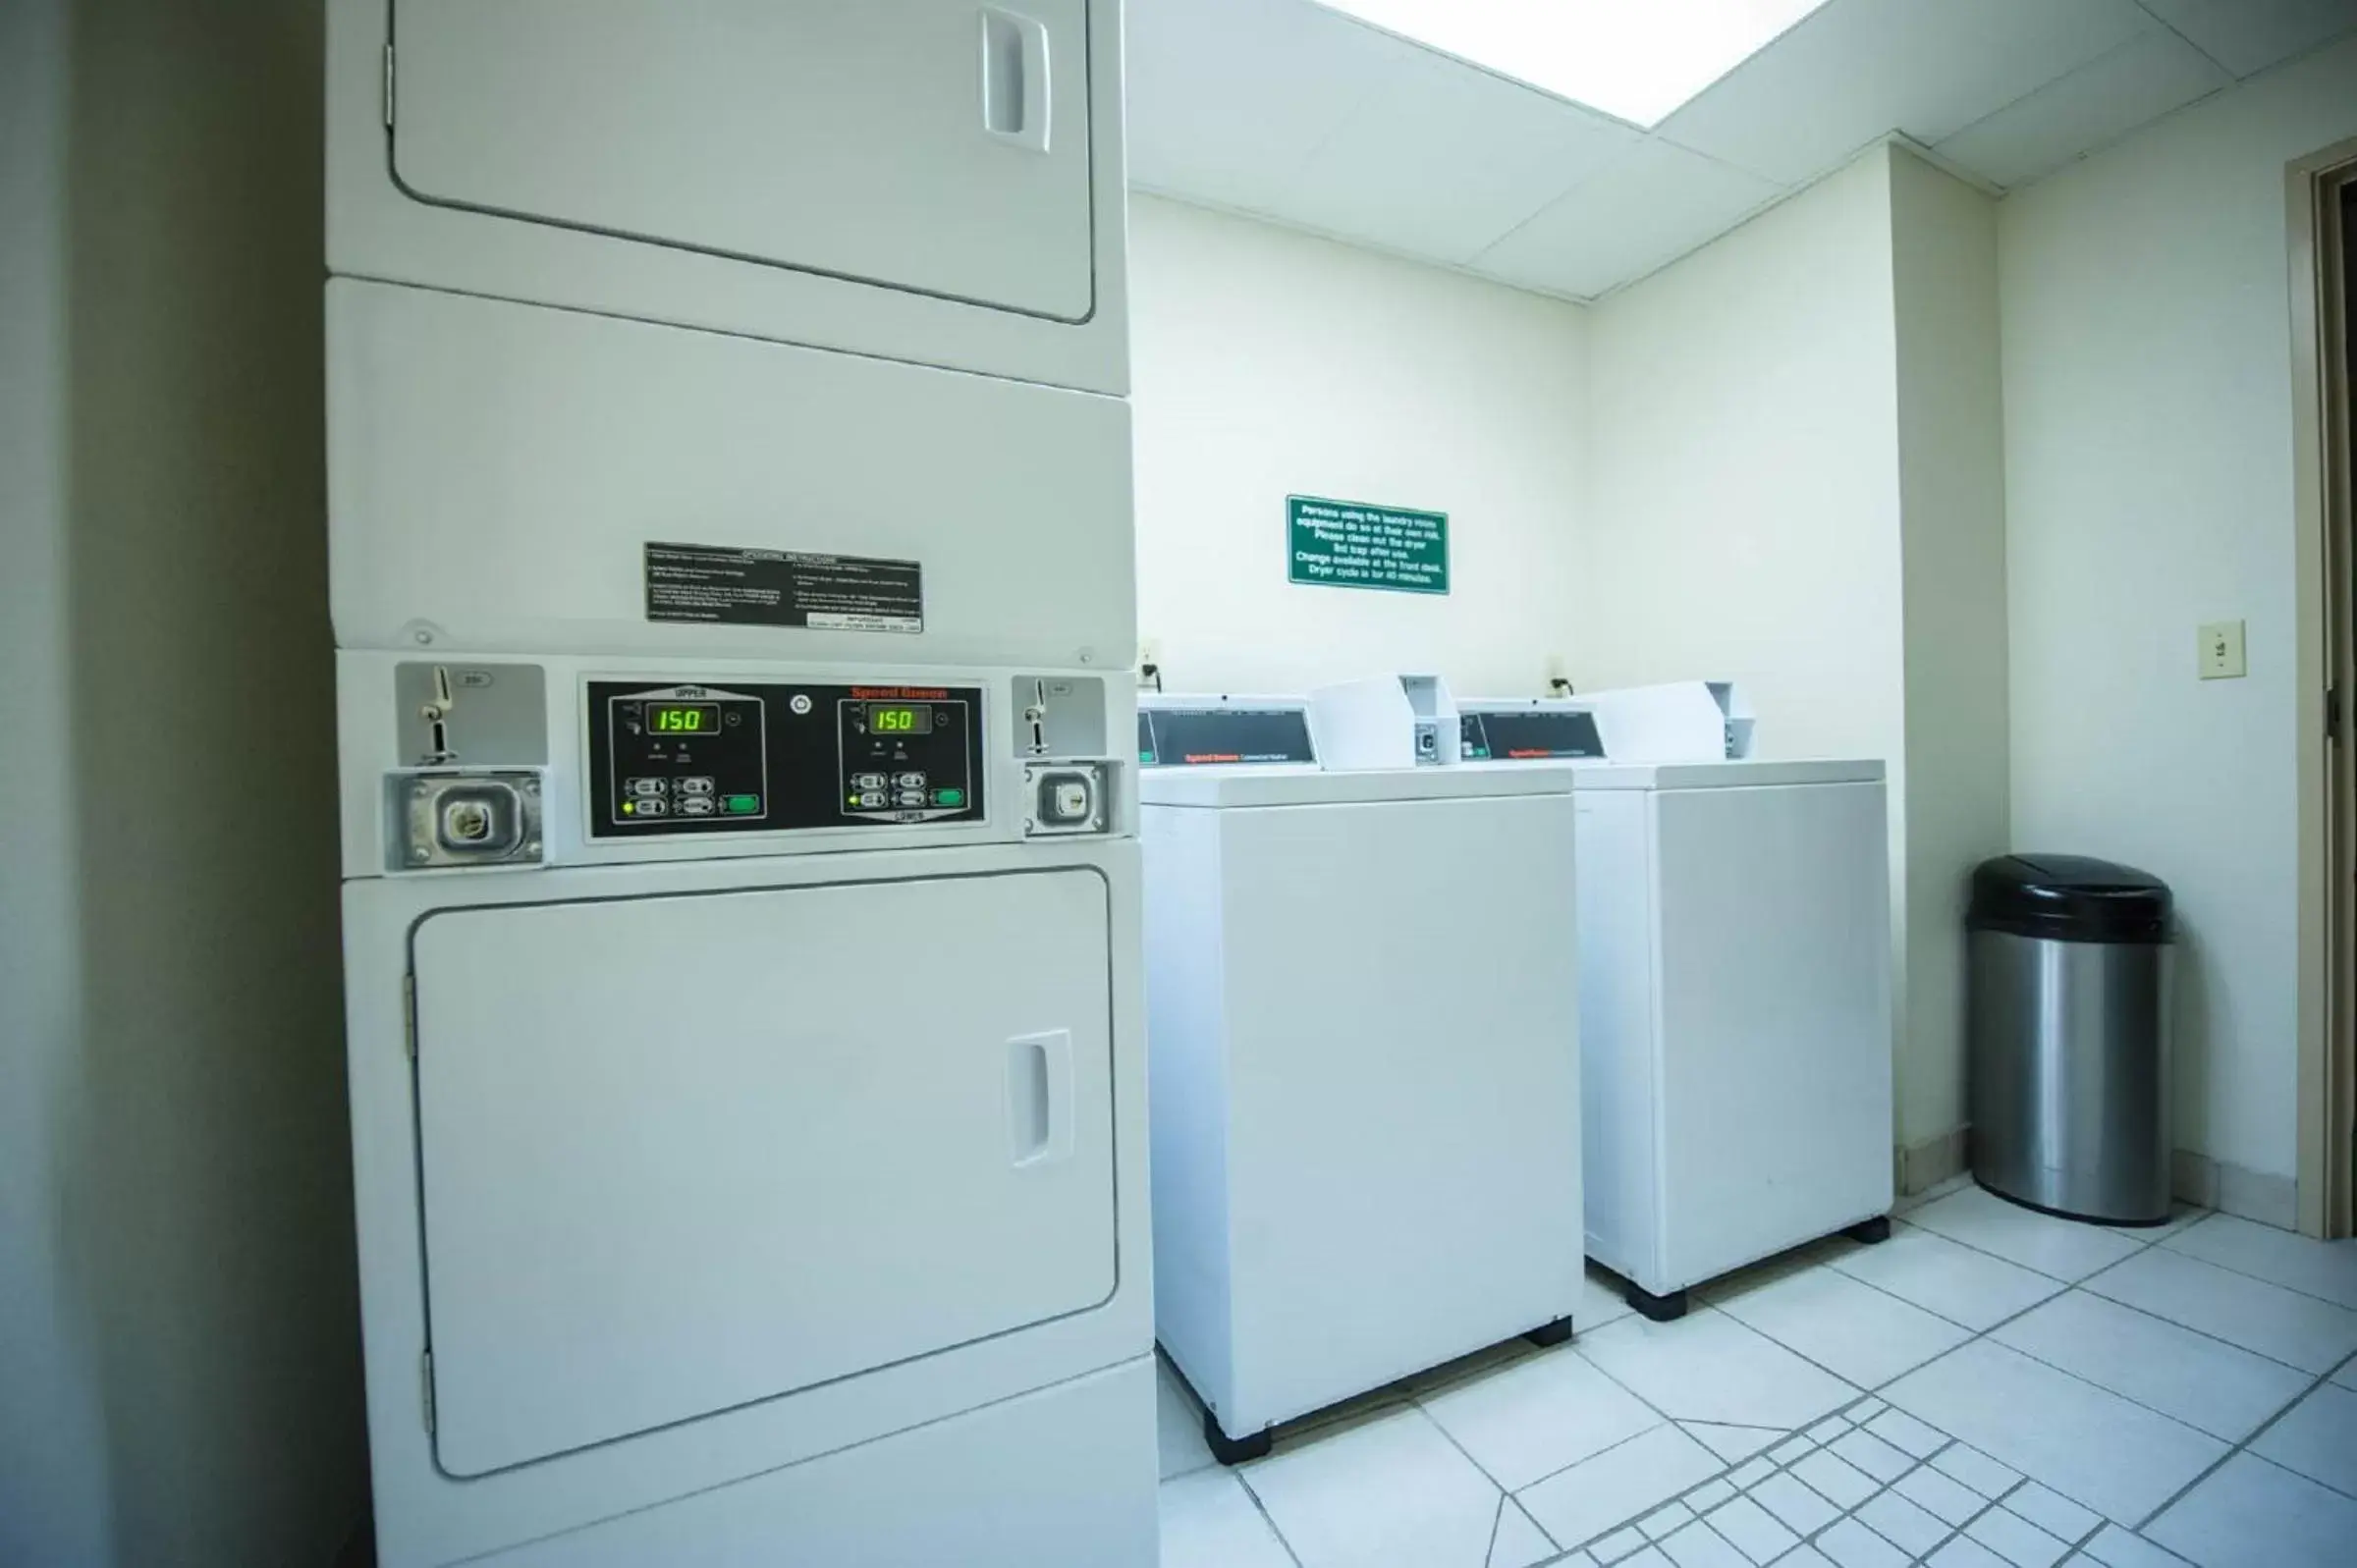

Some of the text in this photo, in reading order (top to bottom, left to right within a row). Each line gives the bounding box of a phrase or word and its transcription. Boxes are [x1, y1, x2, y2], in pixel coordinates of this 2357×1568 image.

[1301, 504, 1339, 517] Persons
[1341, 511, 1364, 522] using
[1366, 512, 1380, 522] the
[1382, 514, 1412, 527] laundry
[1296, 516, 1343, 529] equipment
[1345, 521, 1357, 531] do
[1373, 524, 1382, 533] at
[1384, 525, 1402, 536] their
[1314, 527, 1426, 551] Please clean out the dryer
[1334, 542, 1348, 553] lint
[1349, 545, 1368, 556] trap
[1370, 547, 1390, 557] after
[1296, 551, 1332, 566] Change
[1333, 555, 1370, 567] available
[1383, 559, 1398, 568] the
[1398, 561, 1420, 570] front
[1309, 564, 1335, 577] Dryer
[1337, 567, 1359, 578] cycle
[1361, 568, 1369, 577] is
[1371, 569, 1384, 578] for
[676, 688, 706, 697] UPPER
[851, 687, 948, 699] Speed Queen
[658, 710, 700, 730] 150
[877, 711, 912, 730] 150
